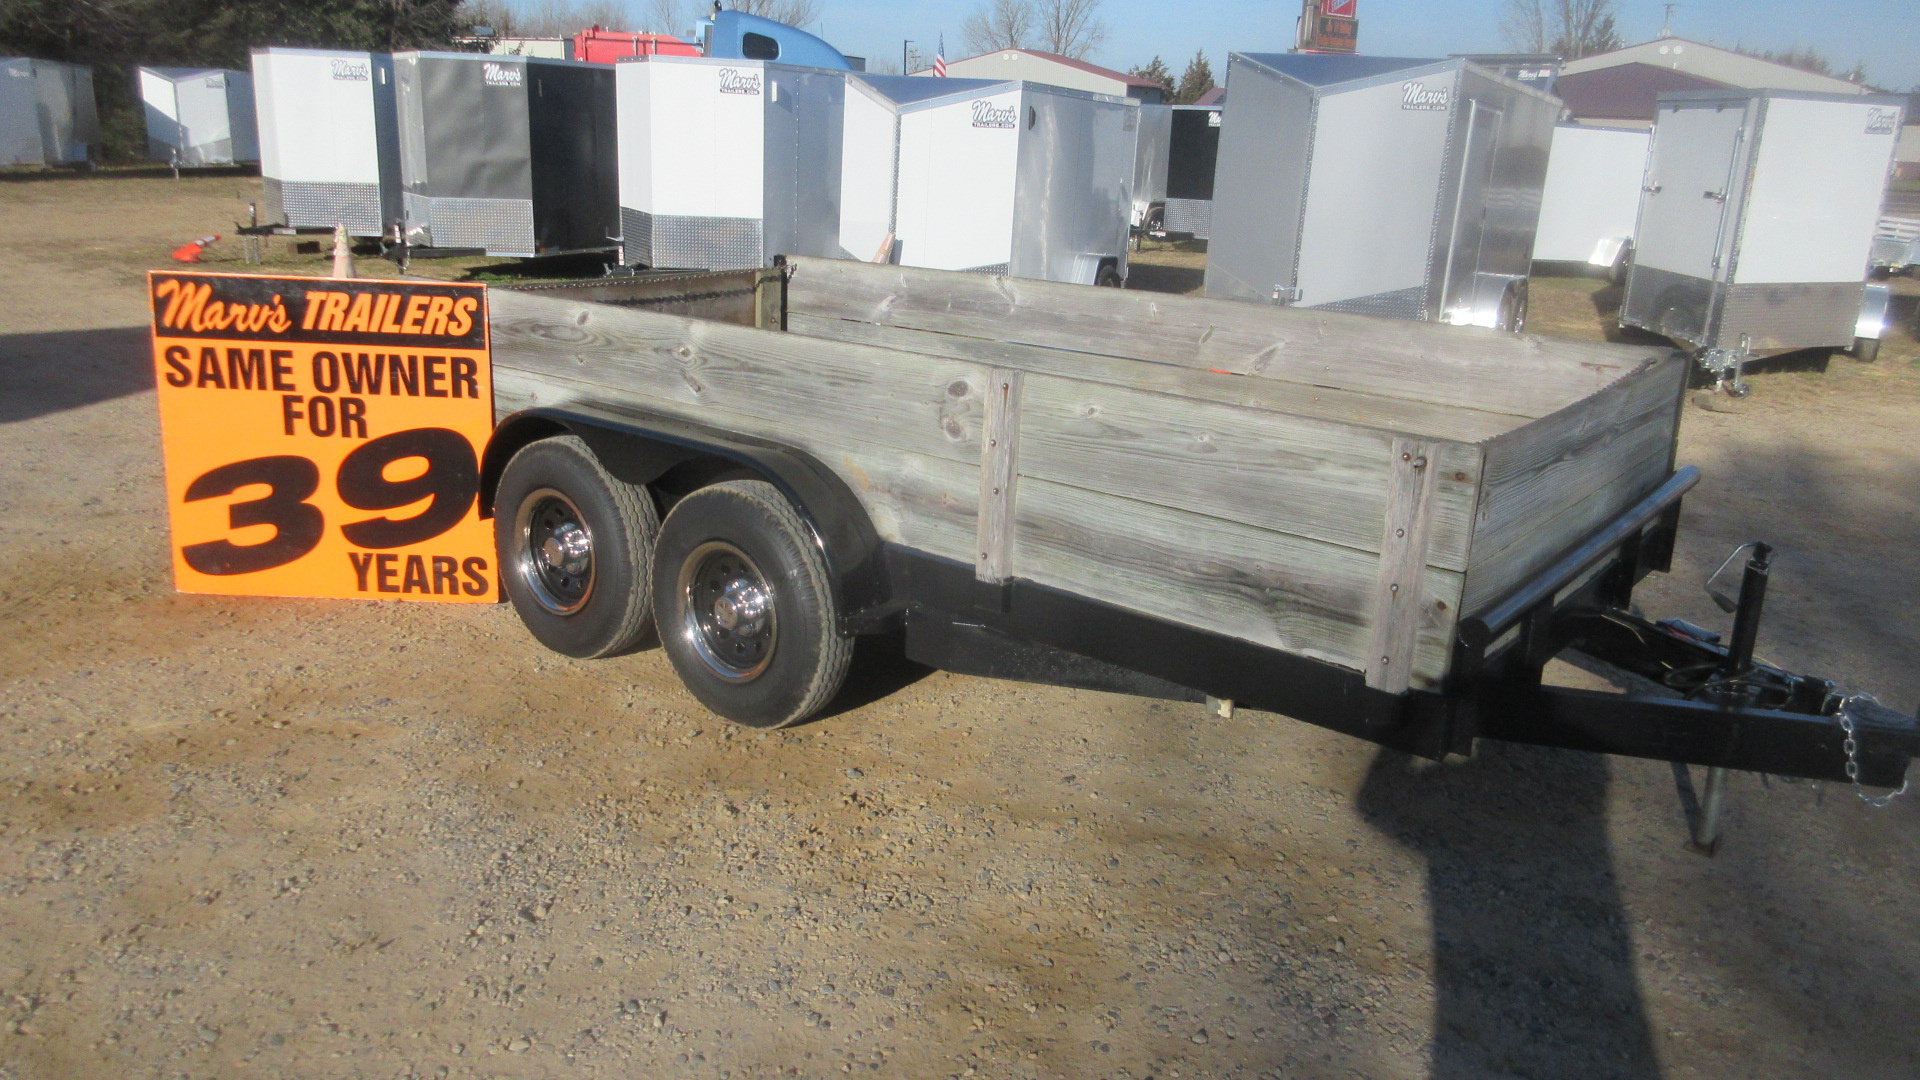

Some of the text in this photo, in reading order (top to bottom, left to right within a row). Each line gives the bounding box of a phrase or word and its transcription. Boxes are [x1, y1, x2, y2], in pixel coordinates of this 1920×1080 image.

[483, 62, 522, 82] Marv's
[719, 68, 761, 89] Marv's
[1403, 81, 1449, 105] Marv's
[972, 99, 1016, 122] Marv's
[156, 279, 477, 336] Marv's TRAILERS
[165, 345, 480, 399] SAME OWNER
[282, 394, 368, 438] FOR
[182, 427, 480, 576] 39
[348, 552, 489, 596] YEARS
